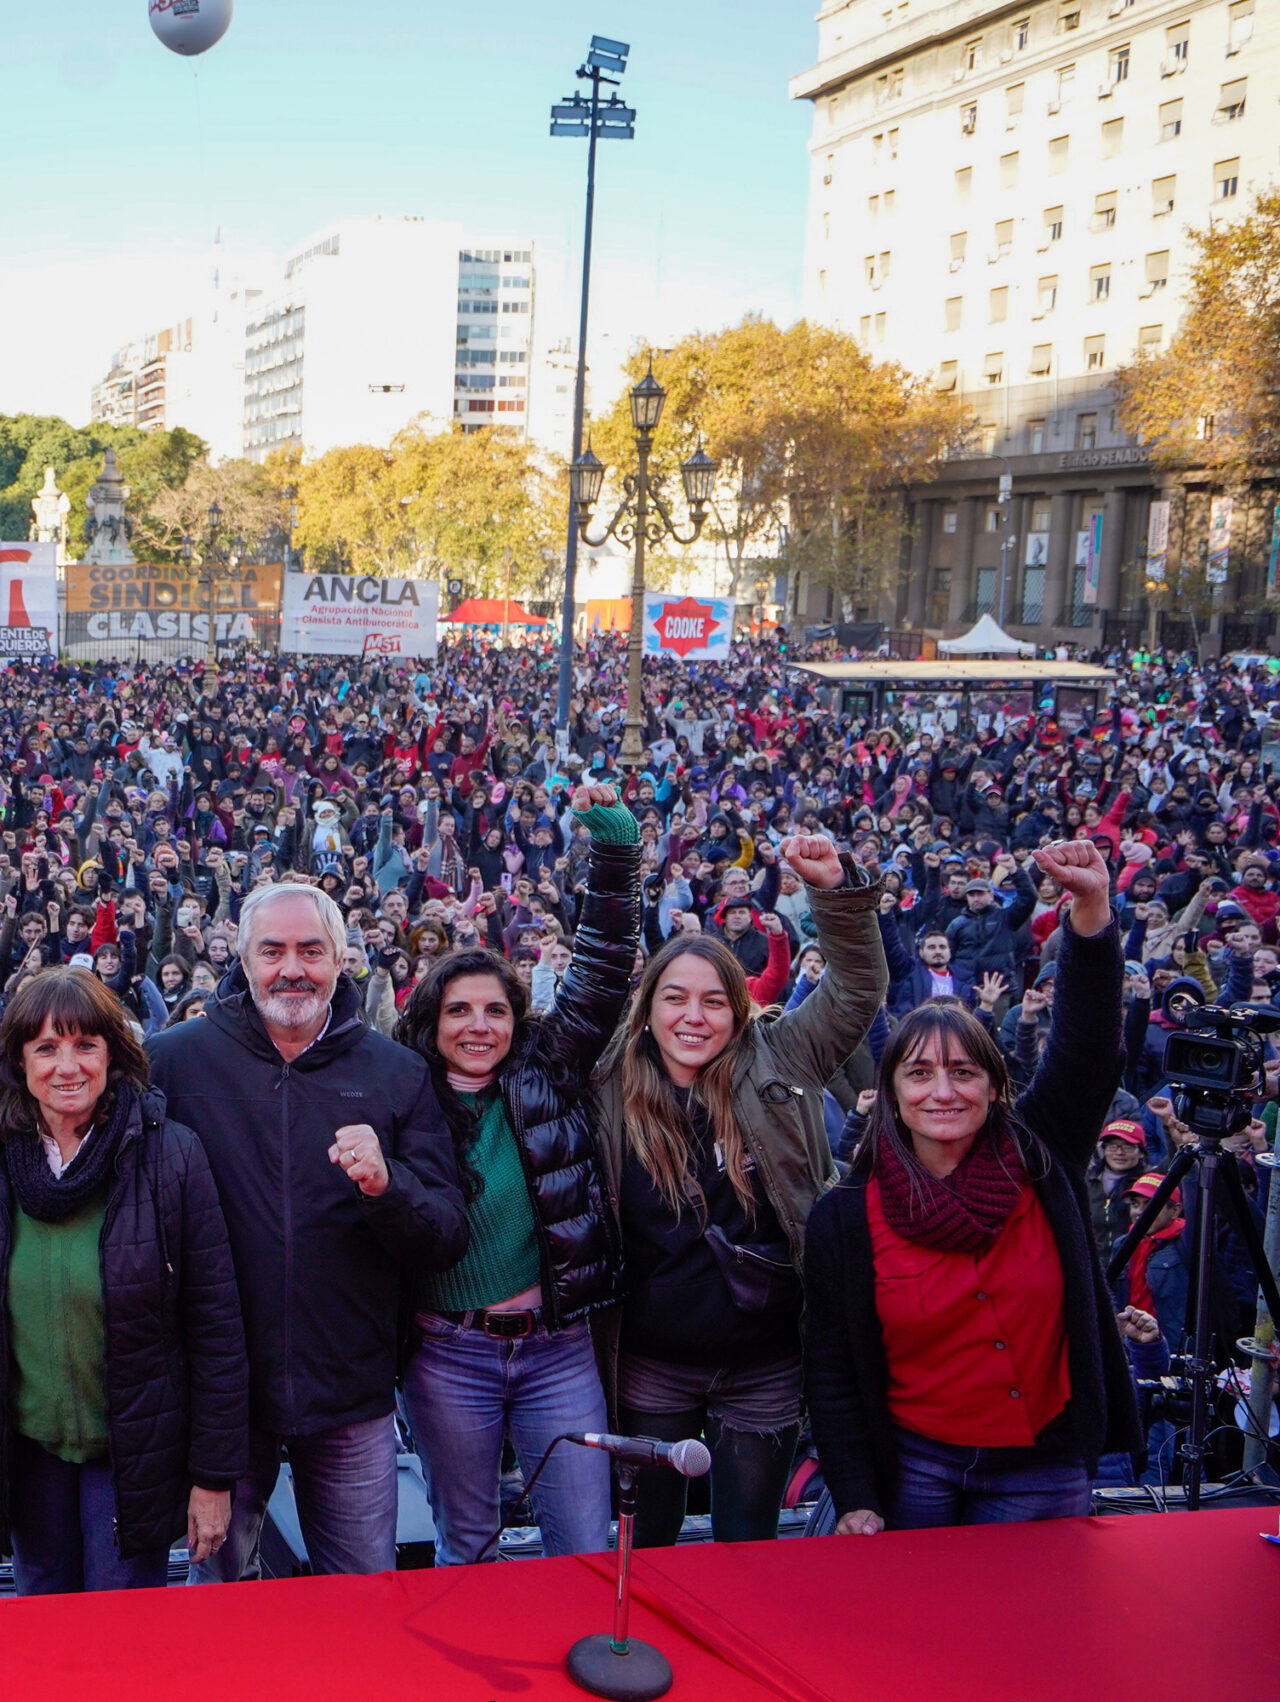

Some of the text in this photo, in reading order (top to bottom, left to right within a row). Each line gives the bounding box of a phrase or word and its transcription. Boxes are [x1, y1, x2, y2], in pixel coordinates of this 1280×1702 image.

[89, 582, 258, 609] SINDICAL
[303, 576, 420, 606] ANCLA
[310, 604, 413, 618] Agrupación Nacional
[87, 611, 257, 641] CLASISTA
[301, 615, 419, 630] Clasista Antiburocrática
[664, 616, 706, 639] COOKE
[32, 631, 45, 640] DE
[363, 633, 401, 653] MST
